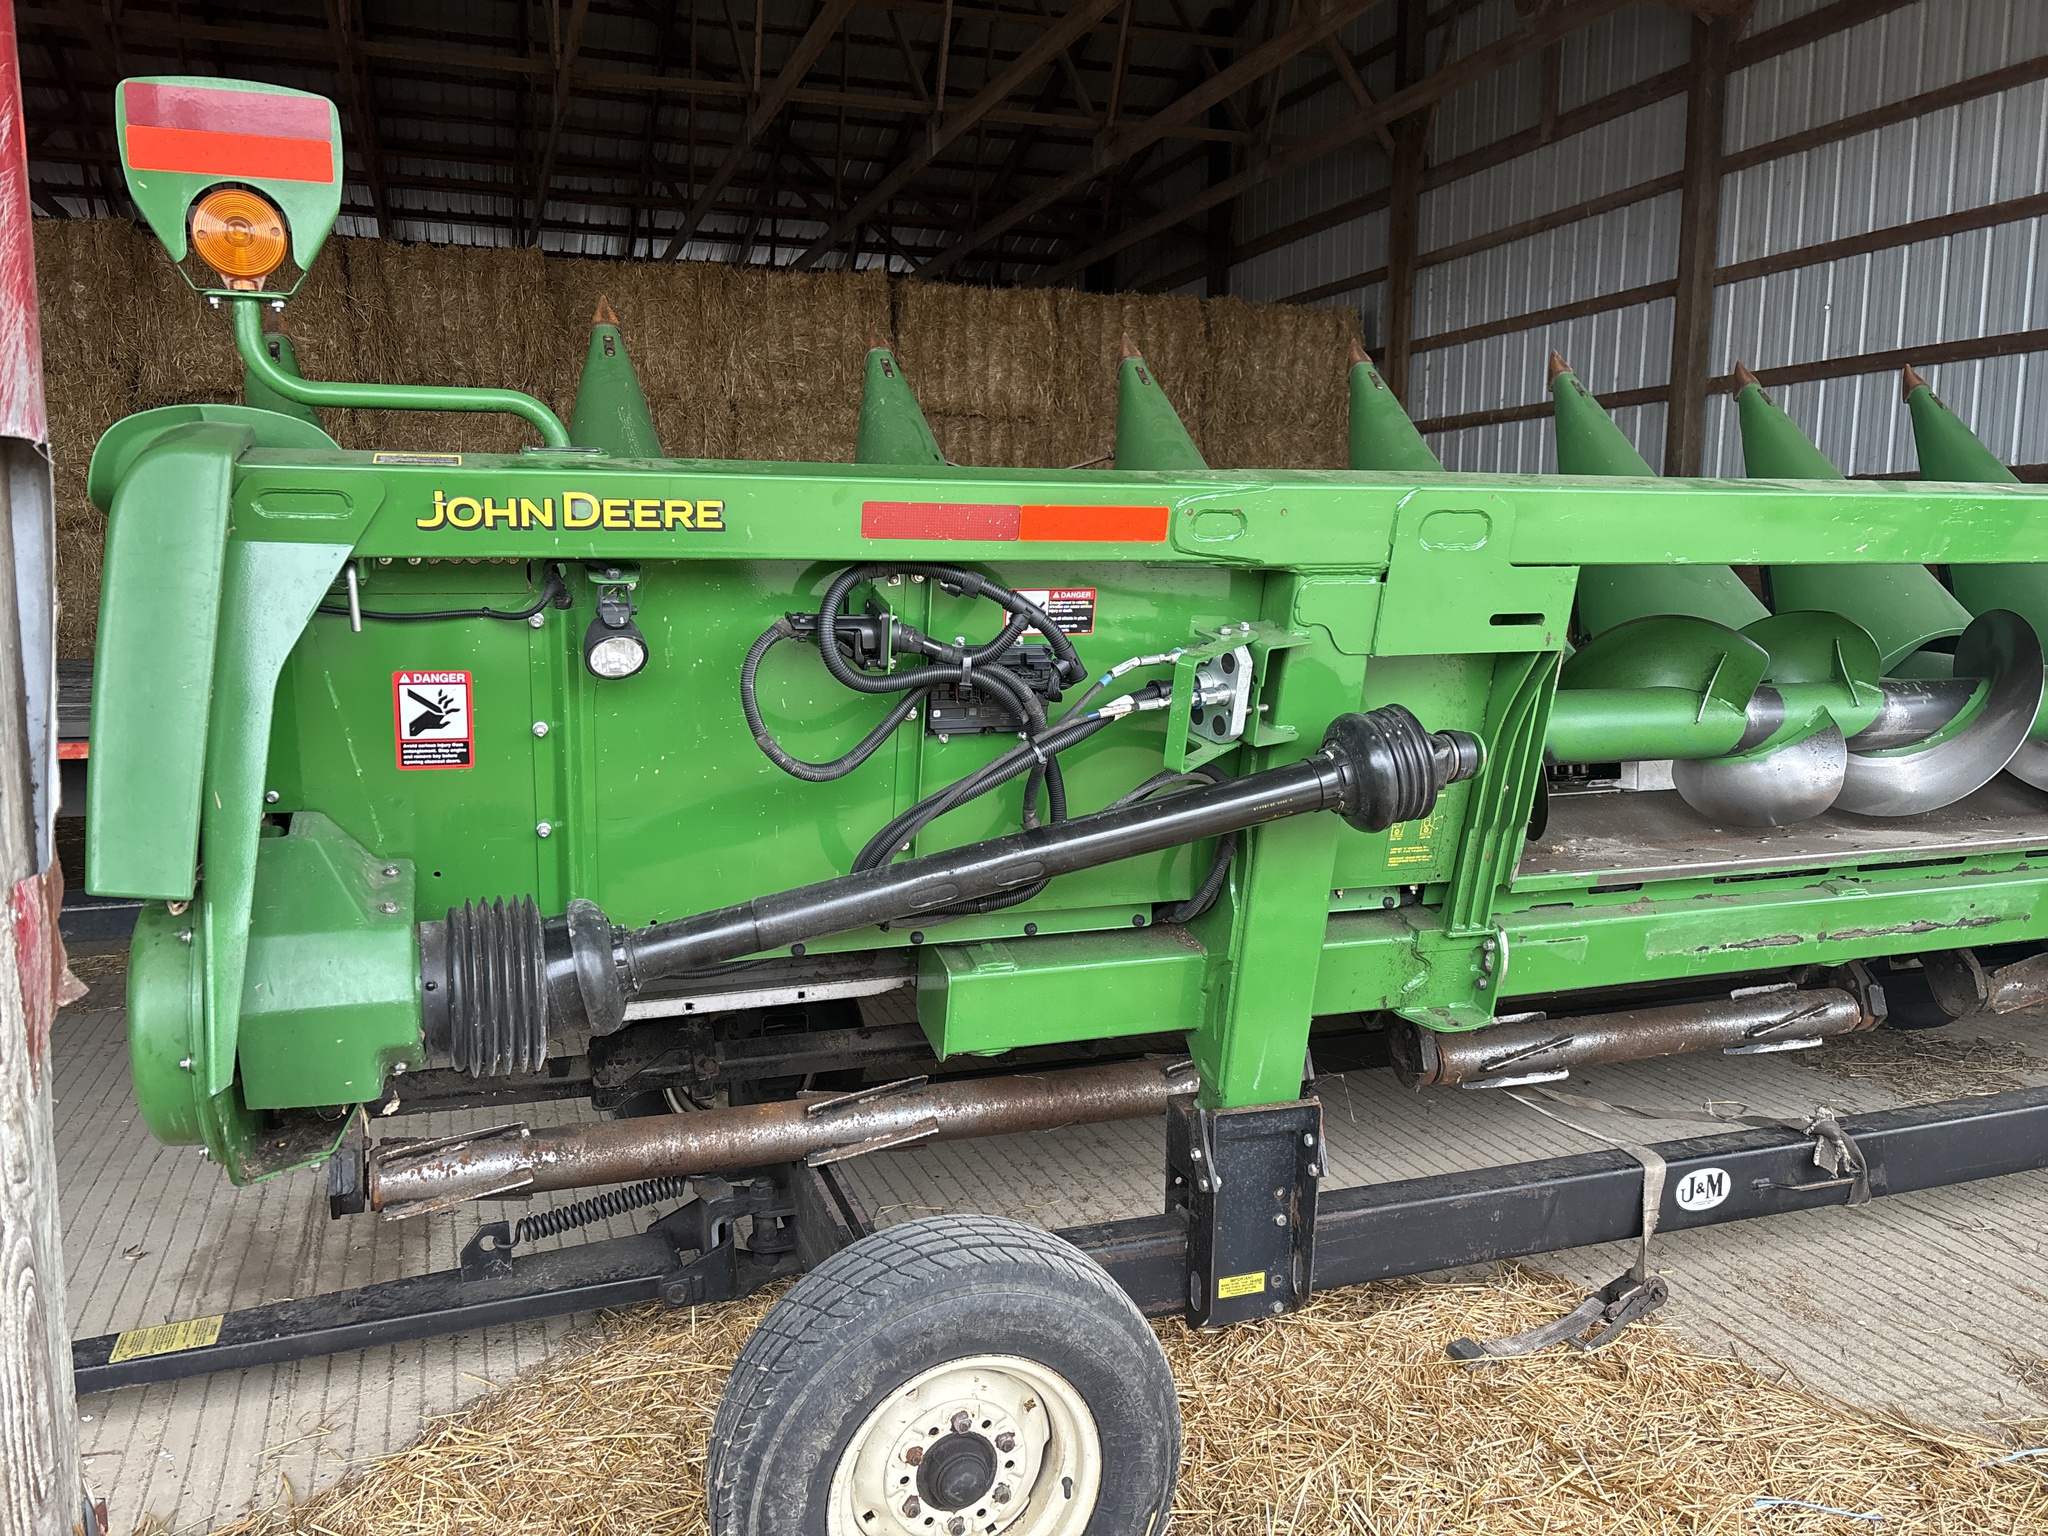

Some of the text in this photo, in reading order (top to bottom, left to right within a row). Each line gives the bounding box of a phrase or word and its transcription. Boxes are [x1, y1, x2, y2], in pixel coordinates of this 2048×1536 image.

[416, 490, 726, 532] JOHN DEERE
[1061, 591, 1091, 599] DANGER
[413, 673, 466, 683] DANGER
[1680, 1172, 1725, 1203] J&M
